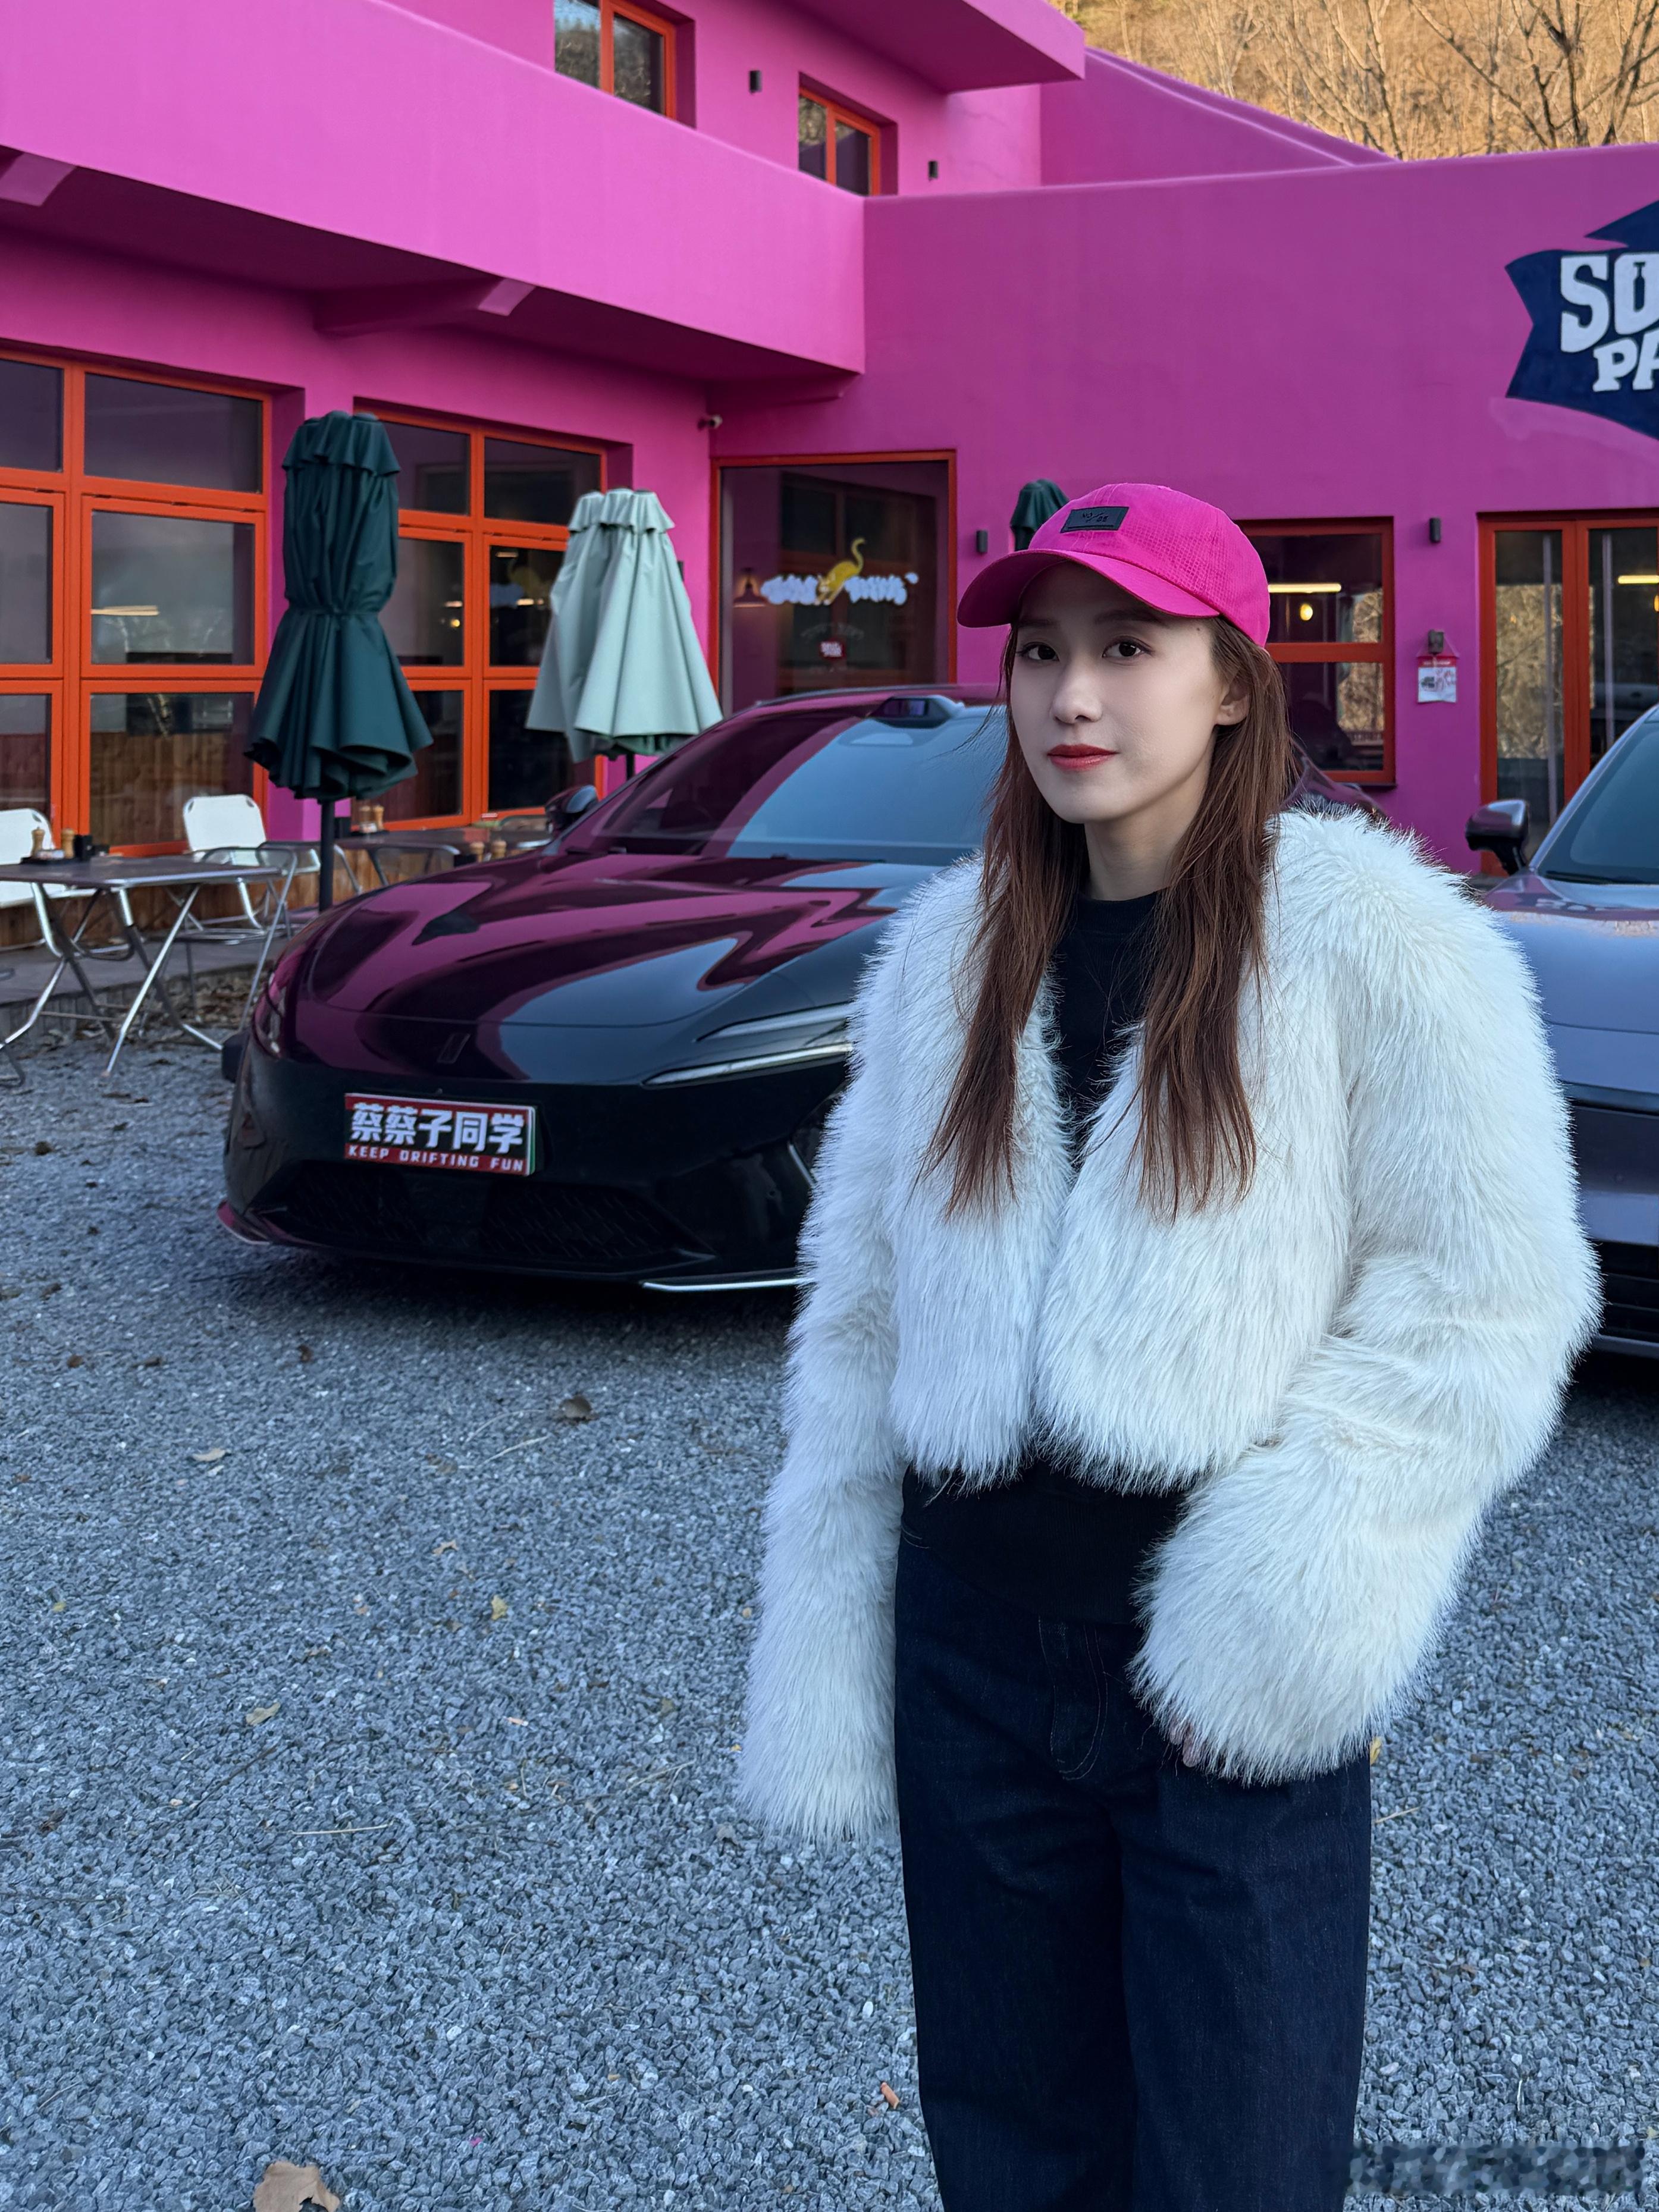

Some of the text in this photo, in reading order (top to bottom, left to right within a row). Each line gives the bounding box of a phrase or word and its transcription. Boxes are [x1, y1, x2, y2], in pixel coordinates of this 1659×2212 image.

[350, 1102, 524, 1154] 蔡蔡子同学
[349, 1144, 524, 1172] KEEP DRIFTING FUN
